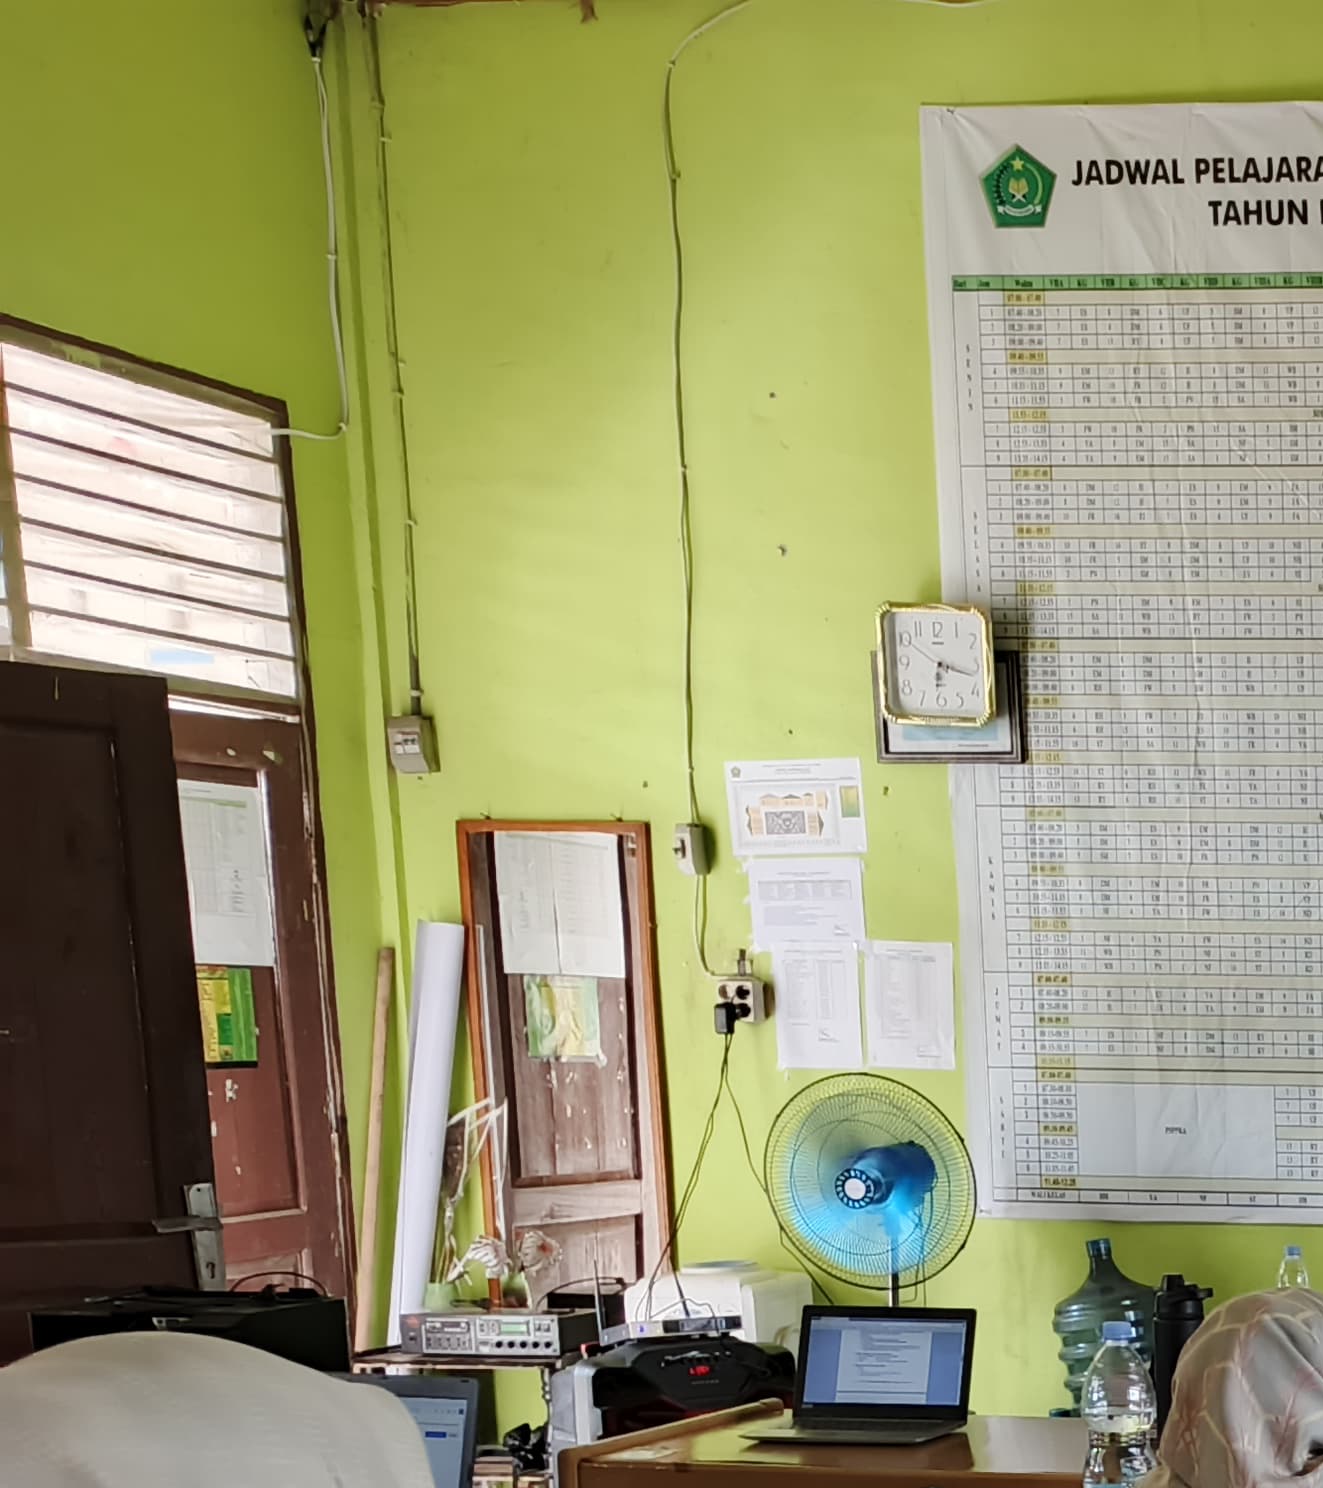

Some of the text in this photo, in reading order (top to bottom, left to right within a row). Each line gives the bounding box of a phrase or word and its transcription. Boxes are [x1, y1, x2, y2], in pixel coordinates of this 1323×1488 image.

[1071, 158, 1185, 186] JADWAL
[1207, 199, 1309, 226] TAHUN
[931, 621, 944, 639] 12
[899, 655, 911, 671] 9
[901, 679, 913, 697] 8
